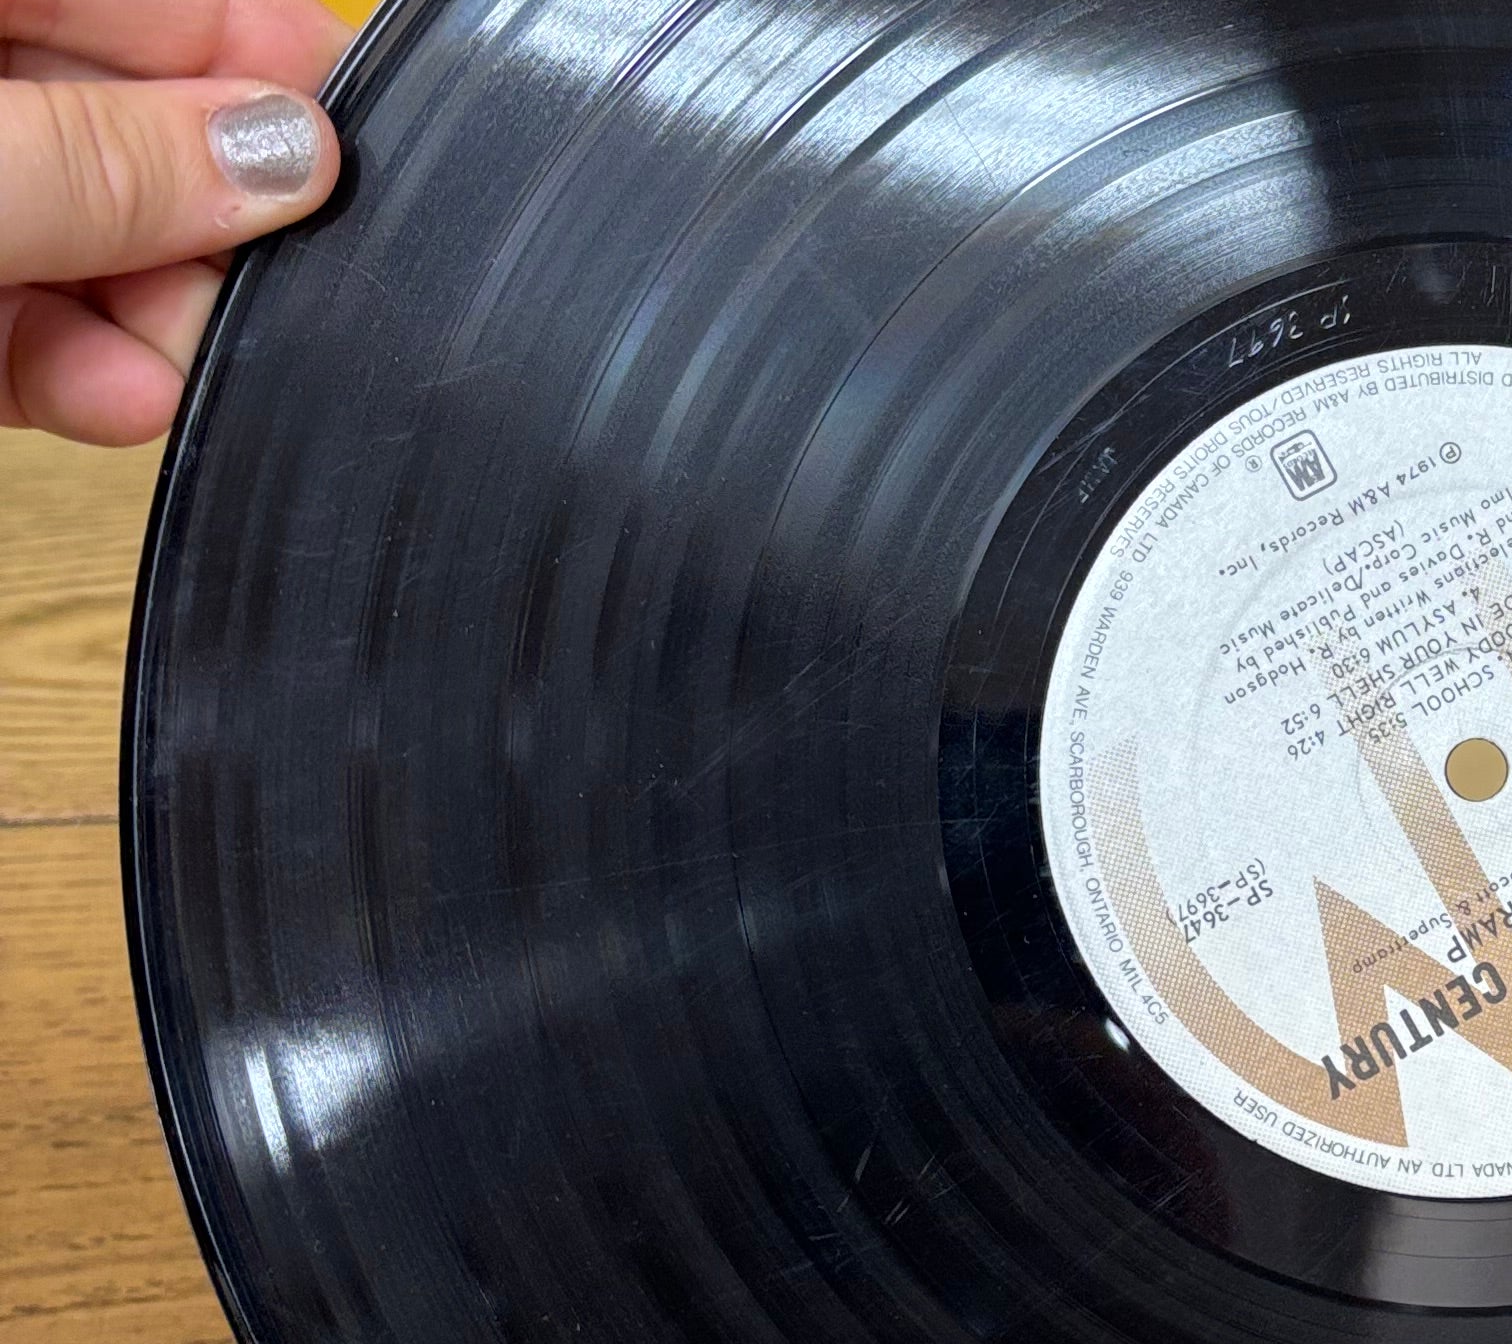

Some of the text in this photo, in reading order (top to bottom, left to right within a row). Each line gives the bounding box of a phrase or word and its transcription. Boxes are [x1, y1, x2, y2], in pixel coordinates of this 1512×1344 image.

[1229, 310, 1305, 368] 3697
[1375, 351, 1443, 374] RIGHTS
[1448, 350, 1482, 366] ALL
[1357, 380, 1379, 398] BY
[1383, 369, 1494, 392] DISTRIBUTED
[1311, 388, 1349, 413] A&M
[1230, 405, 1307, 458] RECORDS
[1172, 429, 1229, 480] DROITS
[1210, 453, 1231, 477] OF
[1395, 455, 1437, 486] 1974
[1154, 472, 1209, 529] CANADA
[1346, 480, 1390, 516] A&M
[1259, 507, 1345, 553] Records,
[1419, 507, 1477, 544] Music
[1466, 527, 1492, 546] R.
[1217, 554, 1258, 576] Inc.
[1321, 518, 1405, 576] (ASCAP)
[1397, 542, 1465, 583] Davies
[1108, 569, 1134, 601] 939
[1278, 542, 1417, 621] Corp./Delicate
[1358, 580, 1392, 610] and
[1362, 589, 1432, 628] Written
[1458, 611, 1486, 637] IN
[1079, 605, 1118, 680] WARDEN
[1218, 618, 1276, 655] Music
[1262, 603, 1357, 664] Published
[1308, 641, 1334, 660] R.
[1327, 582, 1485, 682] 4. ASYLUM 6:30
[1337, 624, 1362, 644] by
[1398, 630, 1458, 671] YOUR
[1223, 655, 1307, 705] Hodgson
[1235, 654, 1260, 673] by
[1398, 656, 1460, 695] WELL
[1324, 660, 1398, 713] SHELL
[1410, 663, 1495, 717] SCHOOL
[1279, 702, 1321, 736] 6:52
[1330, 688, 1398, 738] RIGHT
[1364, 709, 1411, 746] 5:35
[1286, 729, 1325, 761] 4:26
[1068, 730, 1094, 872] SCARBOROUGH,
[1084, 876, 1124, 953] ONTARIO
[1452, 897, 1474, 920] &
[1346, 906, 1455, 981] Supertramp
[1118, 957, 1143, 993] M1L
[1140, 994, 1169, 1025] 4C5
[1320, 960, 1508, 1101] CENTURY
[1281, 1120, 1391, 1169] AUTHORIZED
[1396, 1157, 1423, 1175] AN
